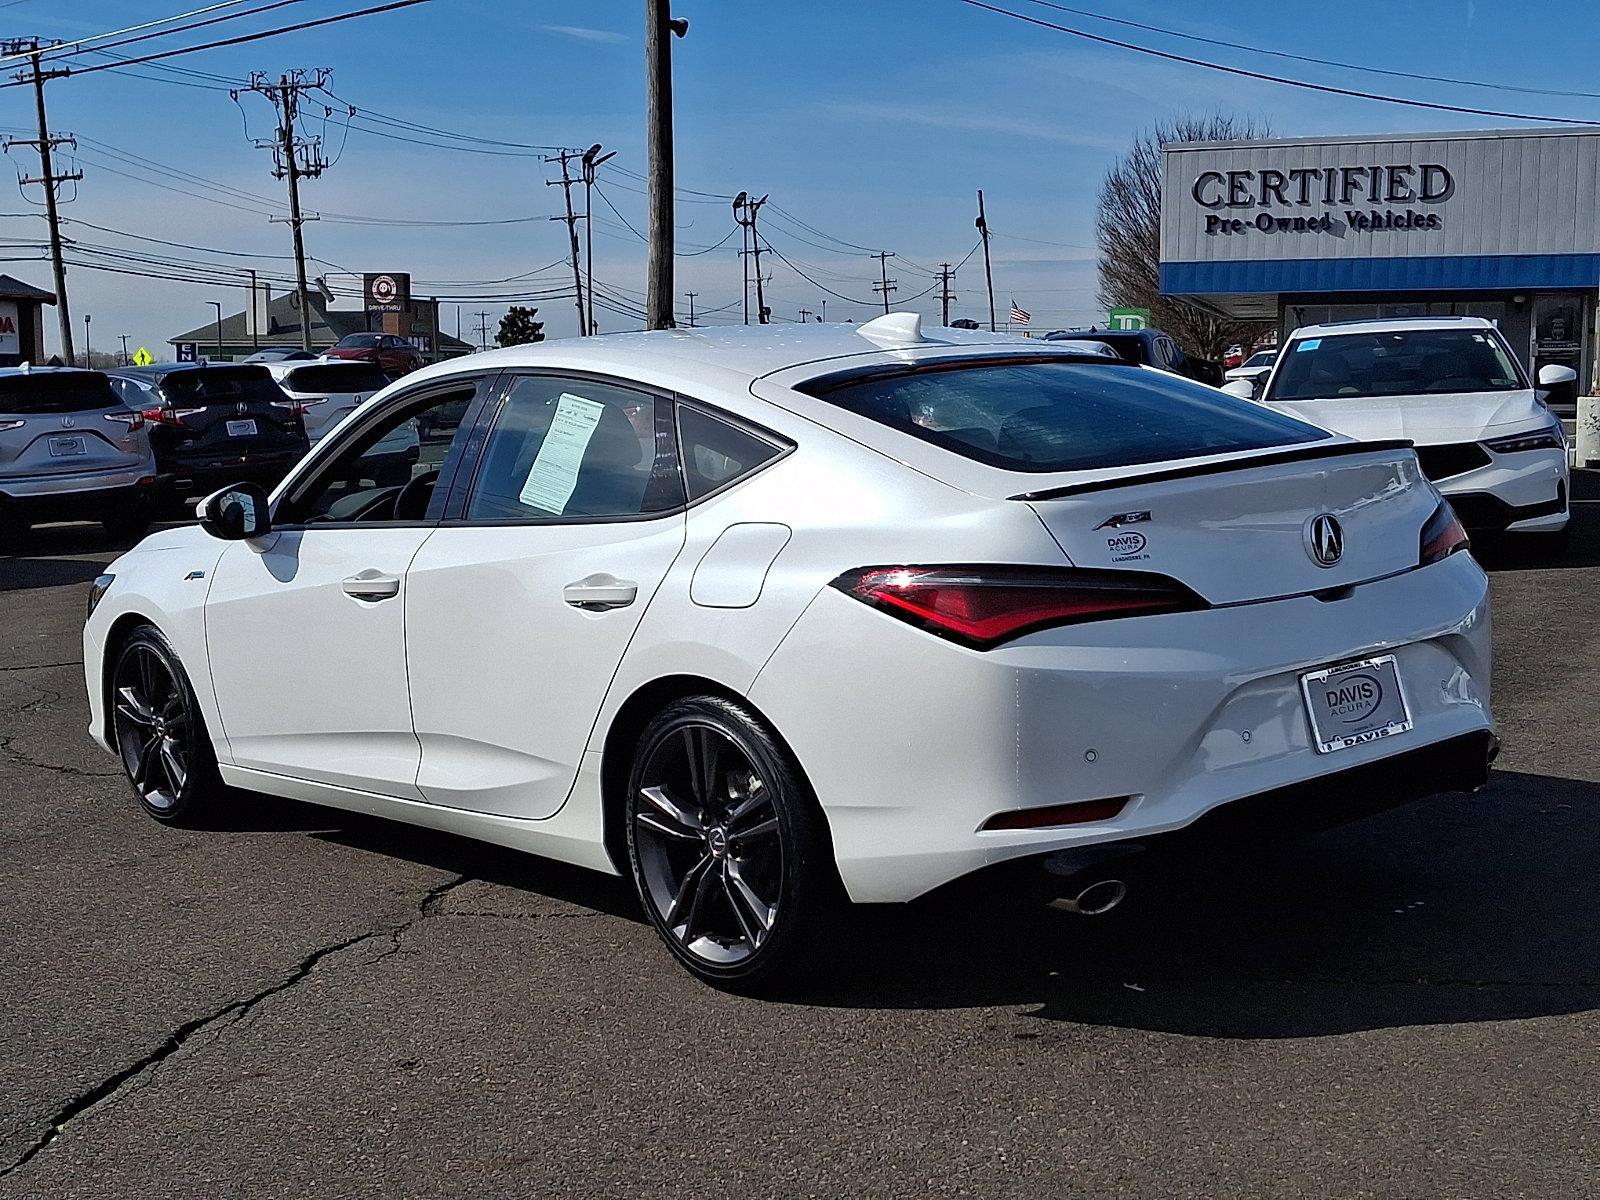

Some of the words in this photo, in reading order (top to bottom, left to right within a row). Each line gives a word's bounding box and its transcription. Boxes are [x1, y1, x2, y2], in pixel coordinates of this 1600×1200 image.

[1191, 164, 1452, 207] CERTIFIED
[1204, 212, 1331, 232] Pre-Owned
[1344, 209, 1438, 229] Vehicles
[1107, 535, 1140, 547] DAVIS
[1109, 544, 1139, 552] ACURA
[1326, 682, 1374, 708] DAVIS
[1330, 700, 1372, 717] ACURA
[1343, 728, 1390, 747] DAVIS
